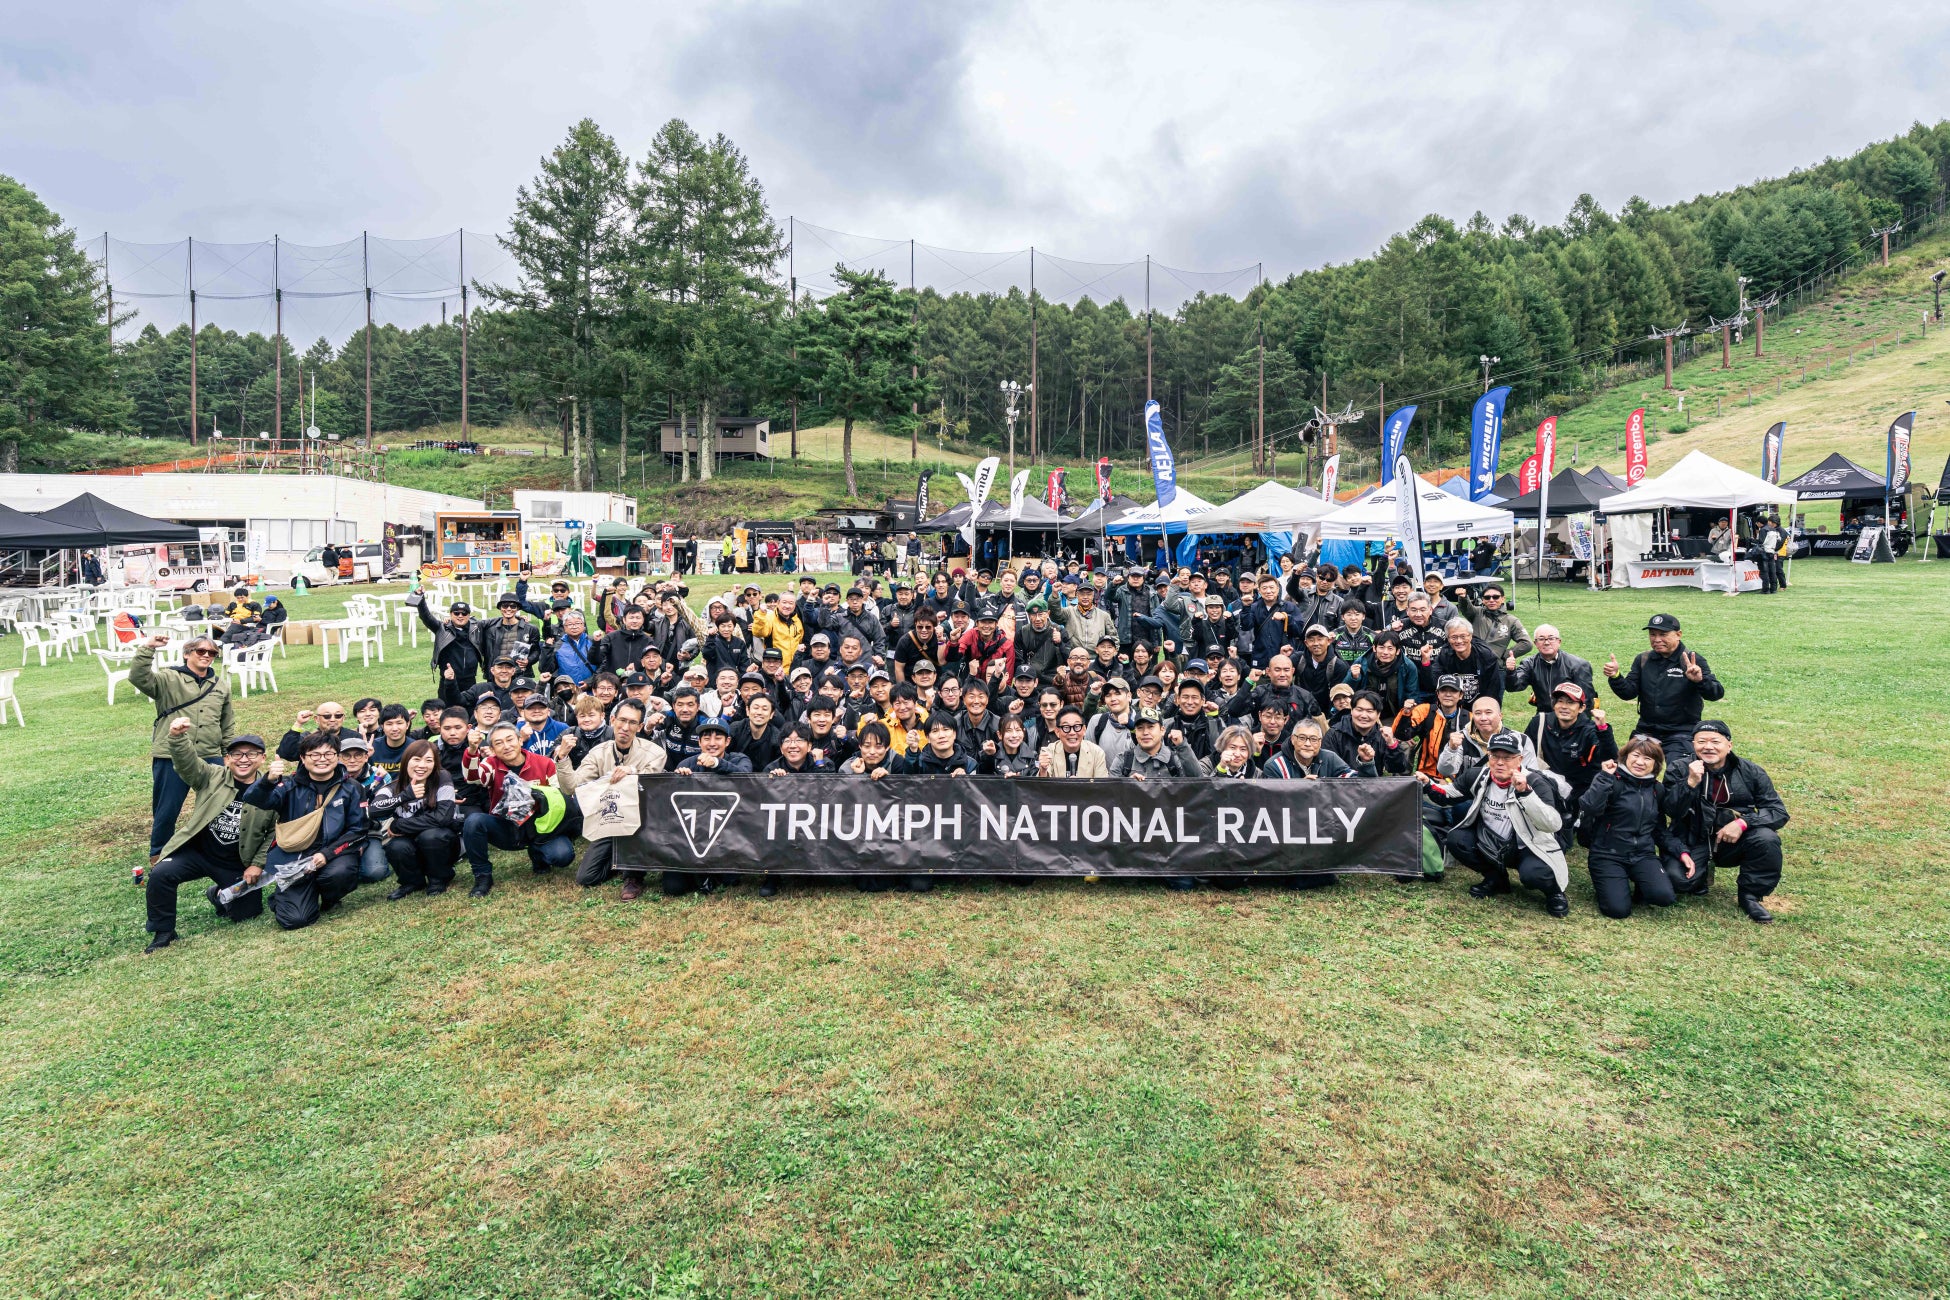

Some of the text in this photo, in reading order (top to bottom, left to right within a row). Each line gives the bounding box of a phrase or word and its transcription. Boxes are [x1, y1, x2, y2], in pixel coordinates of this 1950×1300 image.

[1482, 402, 1495, 470] MICHELIN
[1630, 414, 1643, 463] brembo
[1151, 432, 1172, 480] AELLA
[1368, 496, 1397, 504] SP
[1421, 492, 1448, 501] SP
[1403, 488, 1414, 542] CONNECT
[1457, 522, 1473, 532] SP
[1349, 527, 1367, 535] SP
[1641, 568, 1695, 578] DAYTONA
[760, 803, 1366, 845] TRIUMPH NATIONAL RALLY
